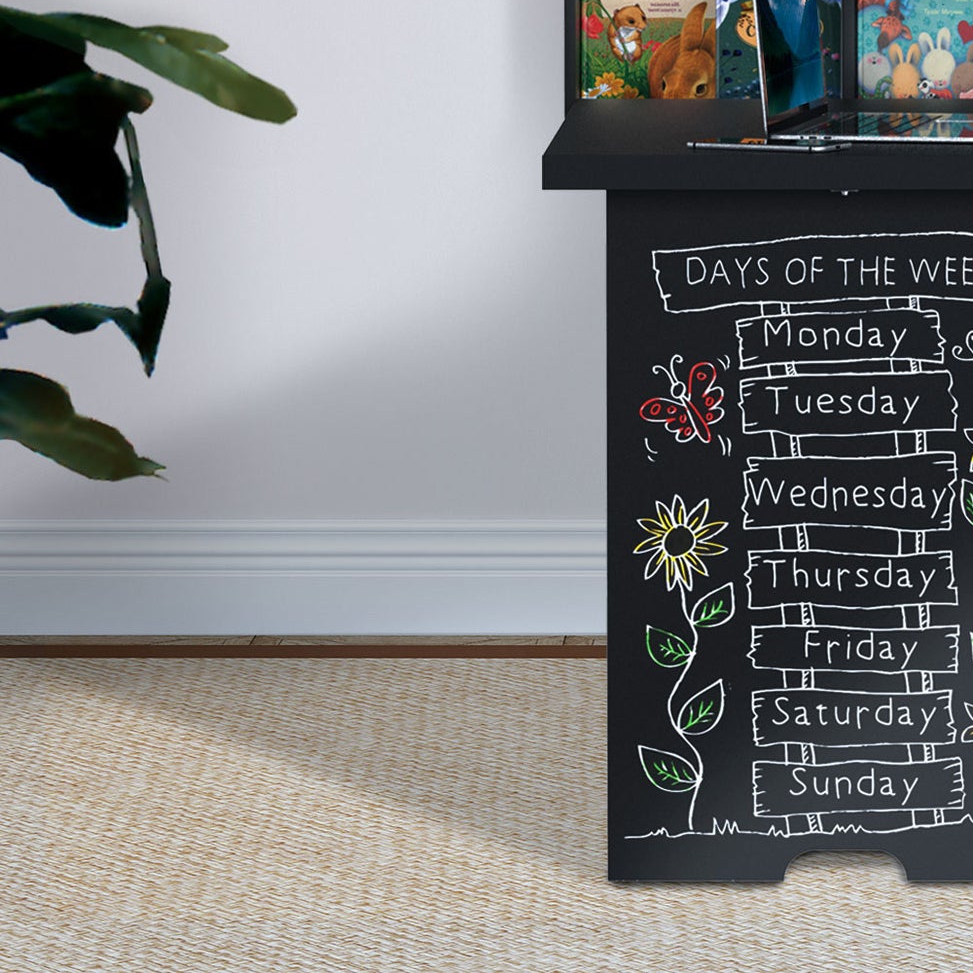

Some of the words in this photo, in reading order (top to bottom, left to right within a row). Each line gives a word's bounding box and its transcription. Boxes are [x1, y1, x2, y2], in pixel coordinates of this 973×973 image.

[686, 256, 770, 289] DAYS
[786, 256, 824, 286] OF
[836, 255, 896, 287] THE
[764, 318, 907, 357] Monday
[764, 385, 920, 425] Tuesday
[748, 476, 948, 519] Wednesday
[762, 557, 936, 598] Thursday
[804, 629, 918, 670] Friday
[771, 696, 937, 736] Saturday
[789, 766, 919, 806] Sunday
